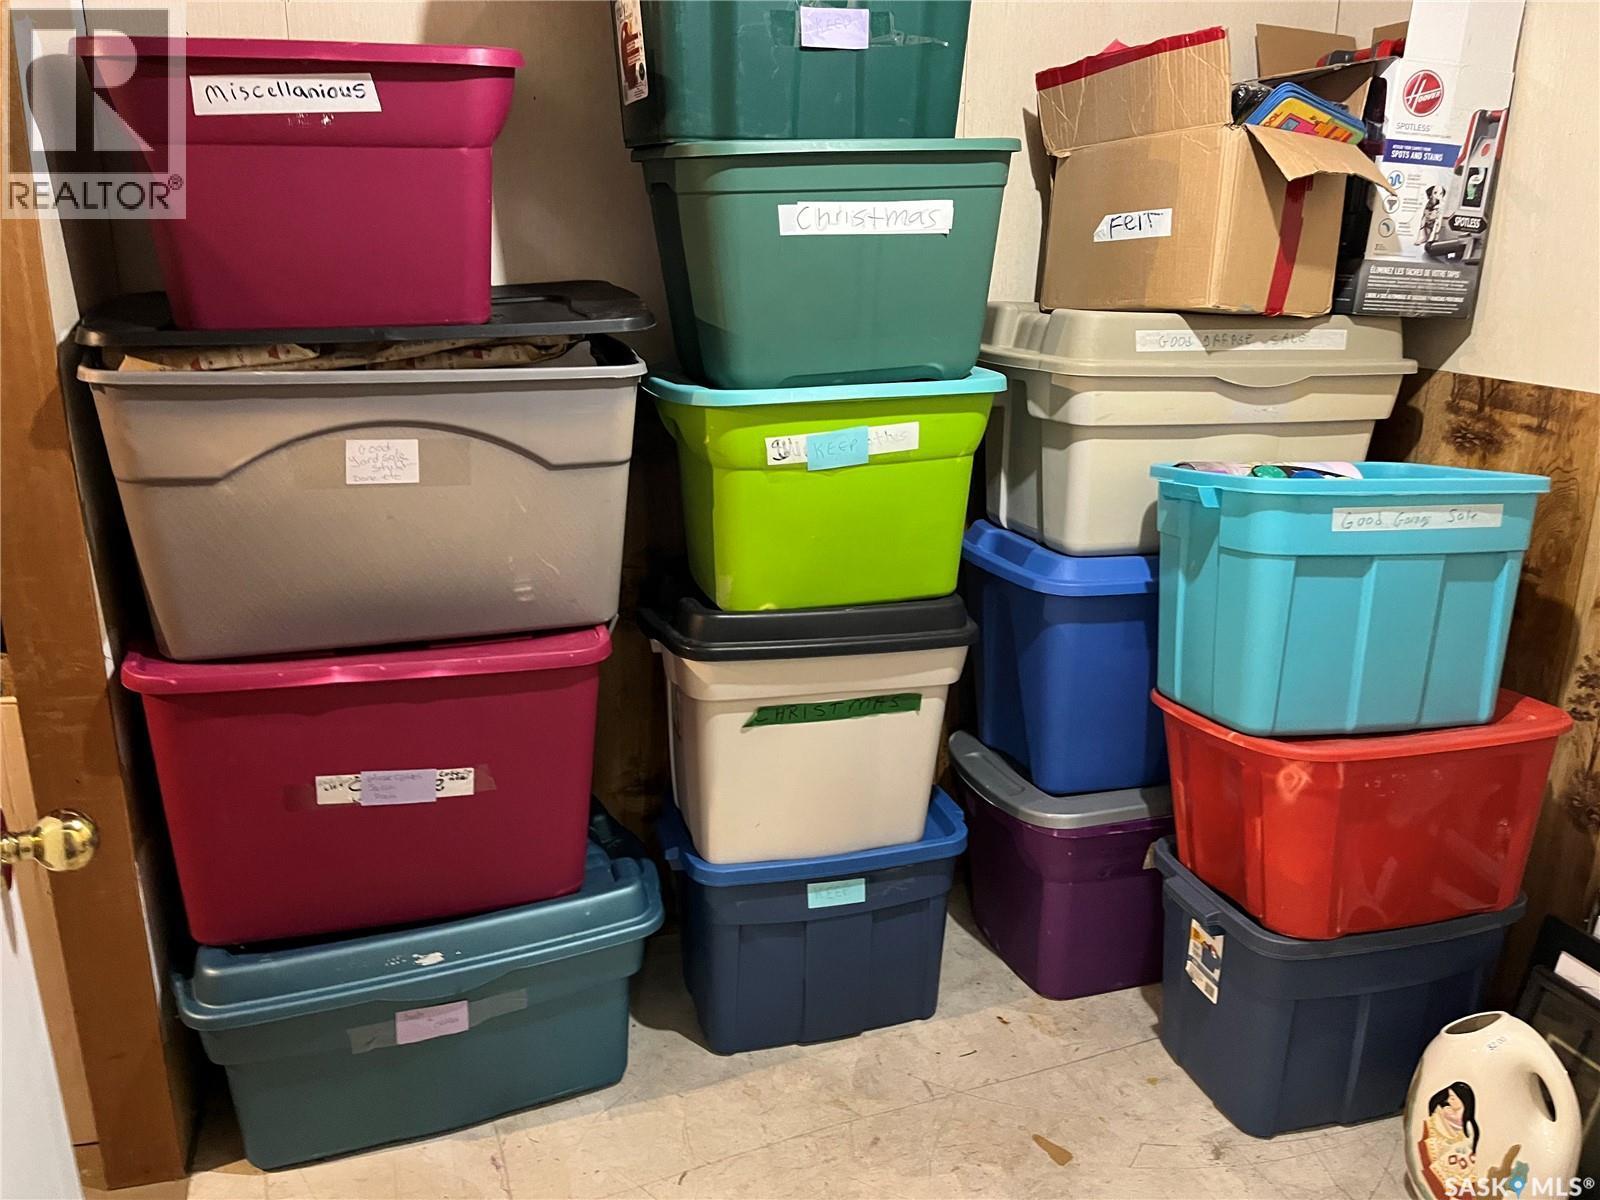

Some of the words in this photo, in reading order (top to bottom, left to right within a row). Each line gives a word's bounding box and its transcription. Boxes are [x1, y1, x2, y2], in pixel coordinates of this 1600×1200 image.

[205, 81, 366, 105] Miscellanious
[1262, 112, 1284, 127] OOL
[1395, 122, 1431, 132] SPOTLESS
[1390, 150, 1410, 159] SPOTS
[1410, 151, 1423, 160] AND
[1423, 152, 1444, 162] STAINS
[796, 206, 941, 229] Christmas
[1453, 217, 1481, 228] SPOTLESS
[813, 438, 858, 459] KEEP
[1341, 511, 1383, 529] Good
[755, 697, 900, 723] CHRISTMAS
